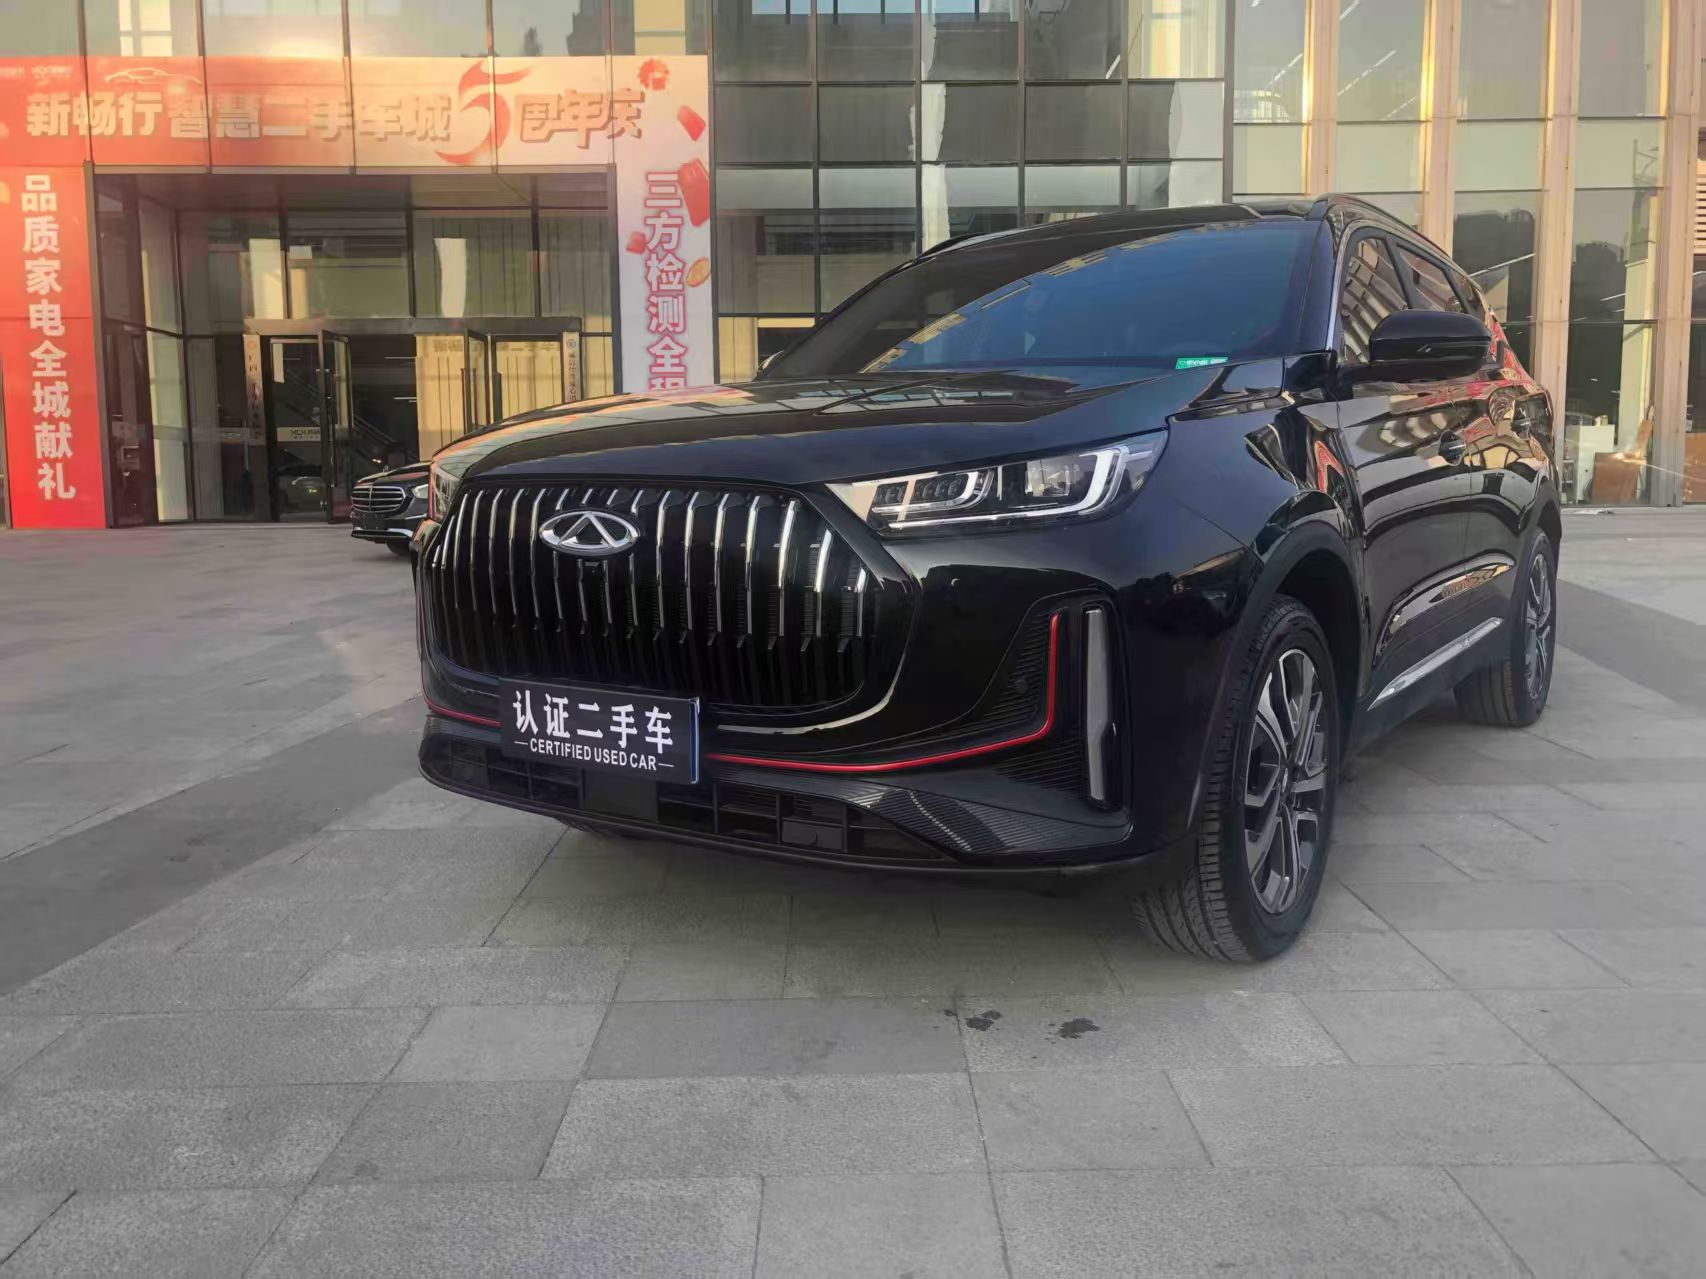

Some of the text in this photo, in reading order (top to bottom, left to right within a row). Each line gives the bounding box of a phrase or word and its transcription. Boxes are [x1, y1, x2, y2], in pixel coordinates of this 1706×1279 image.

[21, 174, 76, 500] 品质家电全城献礼
[512, 689, 674, 754] 认证二手车
[530, 738, 657, 771] CERTIFIED USED CAR
